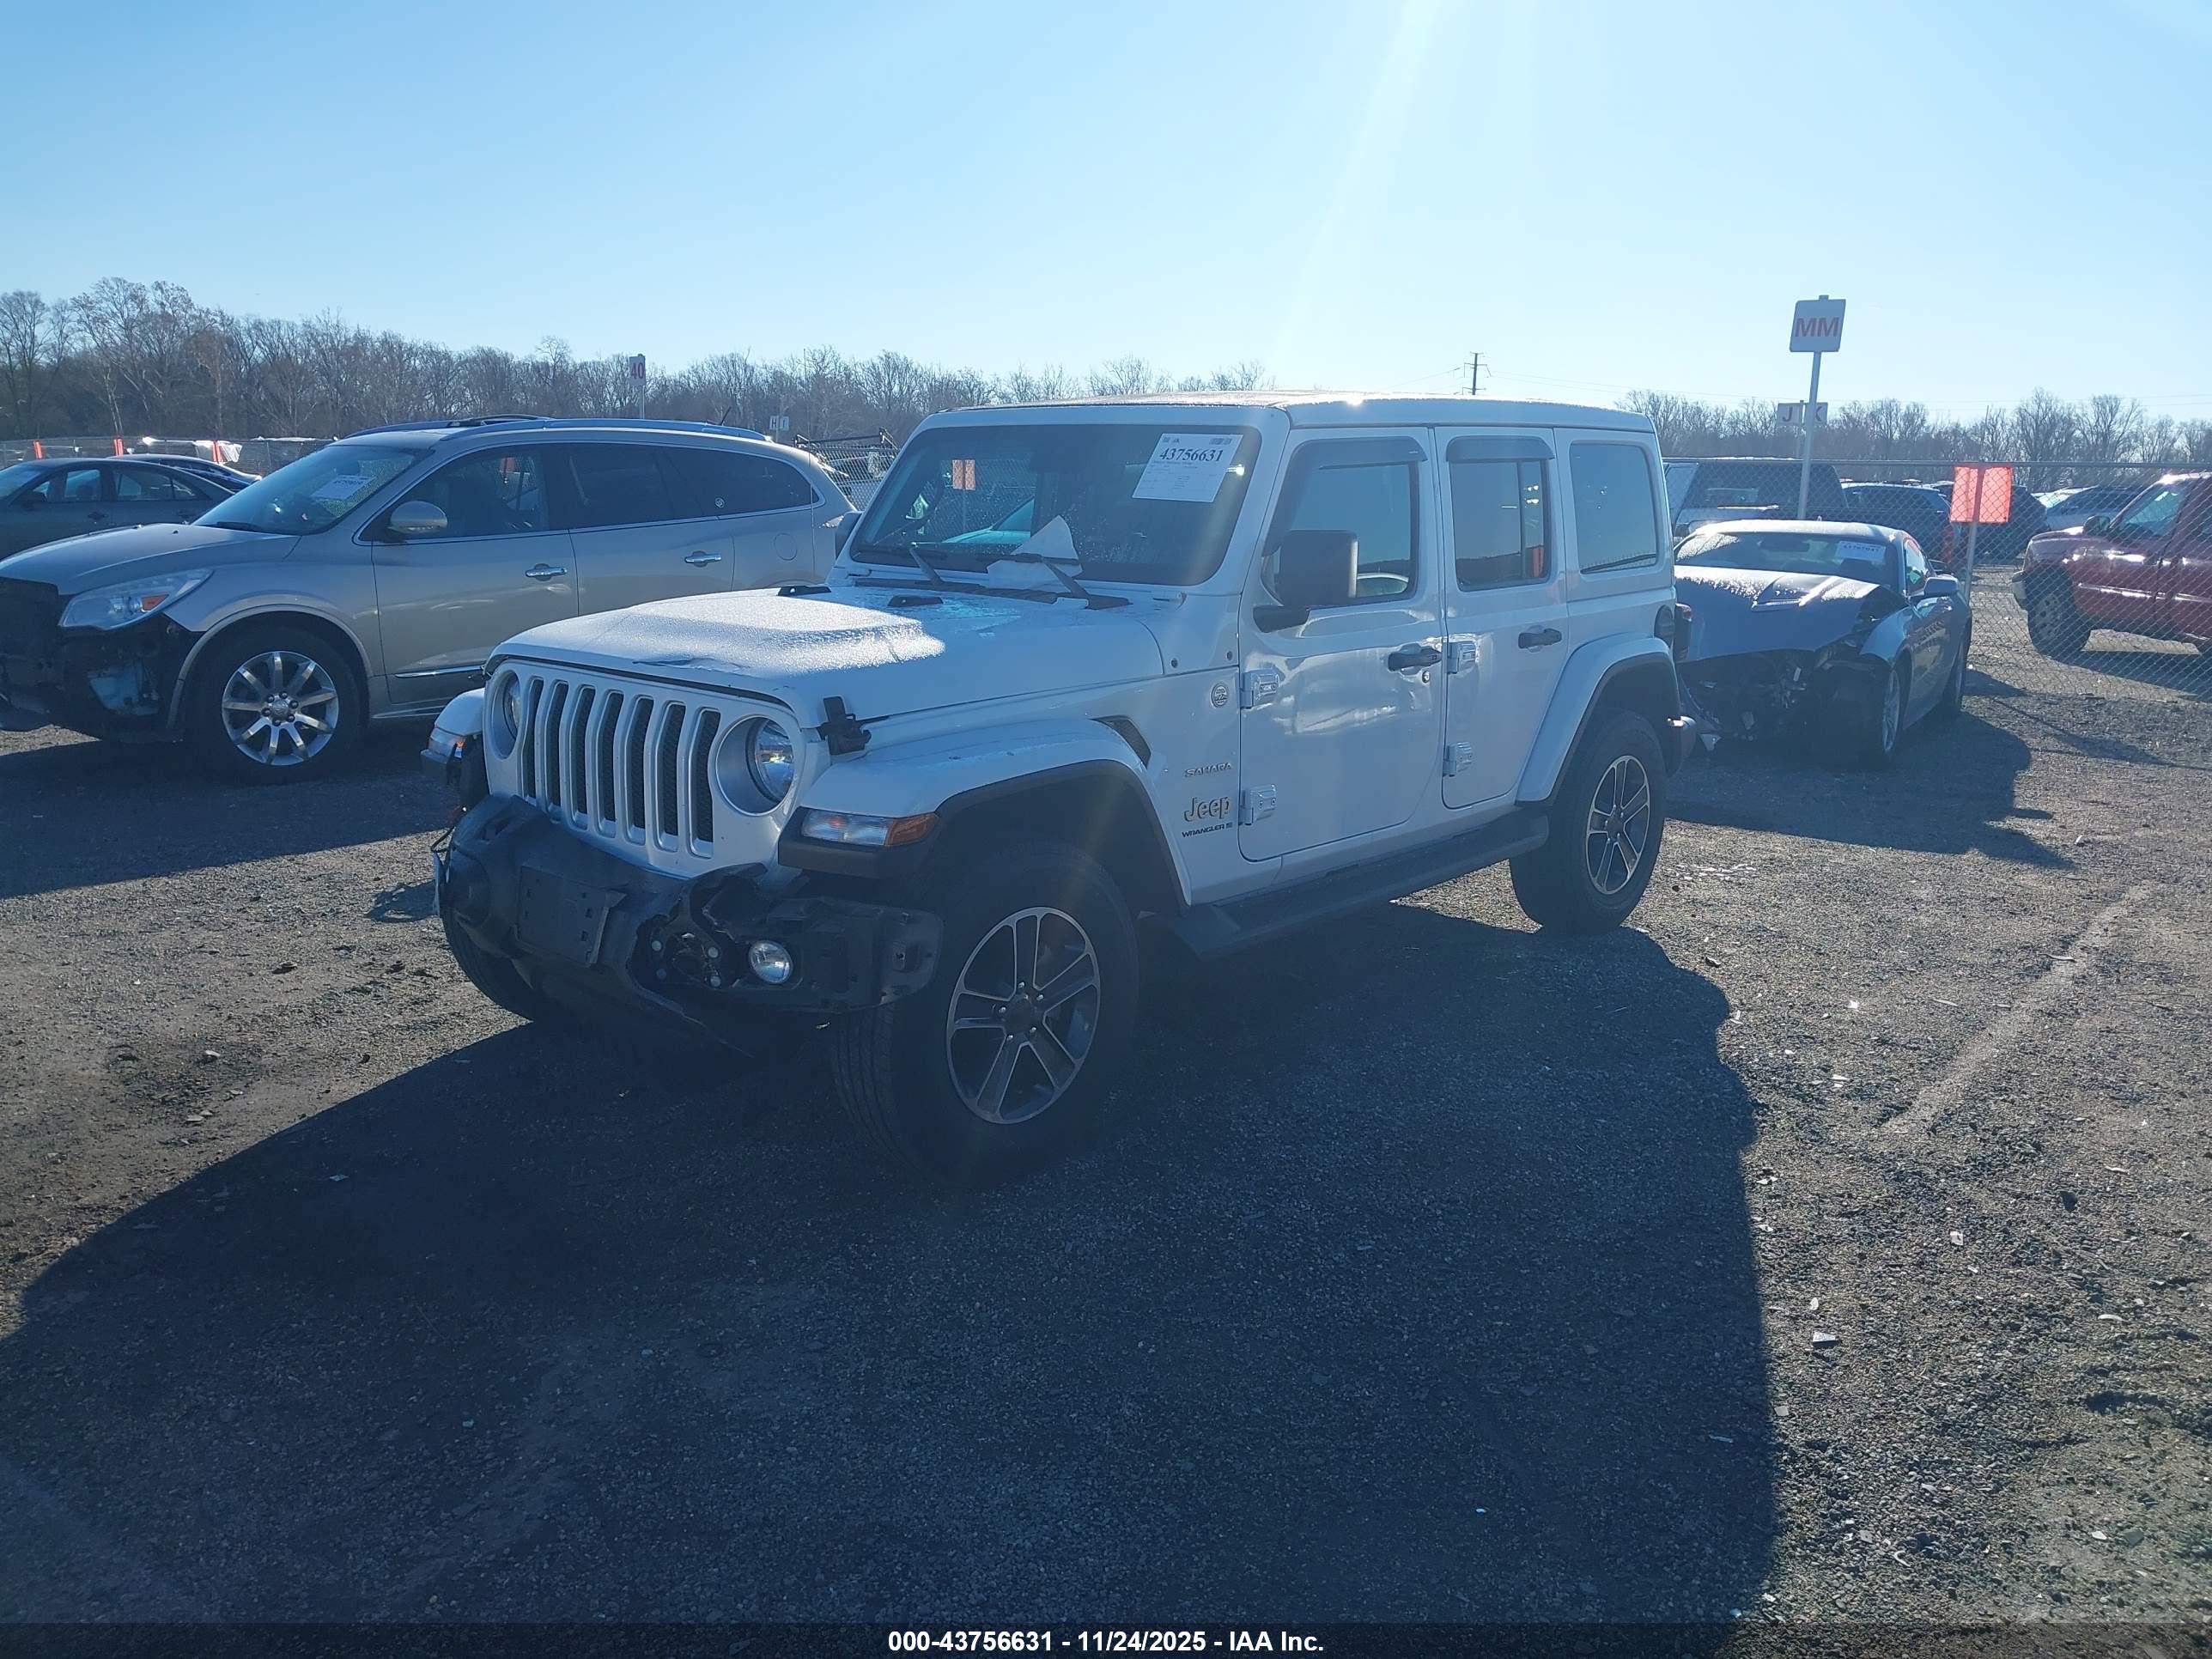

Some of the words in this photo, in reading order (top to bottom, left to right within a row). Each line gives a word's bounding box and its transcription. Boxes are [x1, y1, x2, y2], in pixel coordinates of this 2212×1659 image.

[1795, 317, 1839, 337] MM
[631, 362, 645, 380] 40
[1782, 406, 1793, 422] J
[1159, 447, 1224, 462] 43756631
[1184, 762, 1232, 777] SAHARA
[1183, 796, 1231, 822] Jeep
[1182, 823, 1224, 838] WRANGLER
